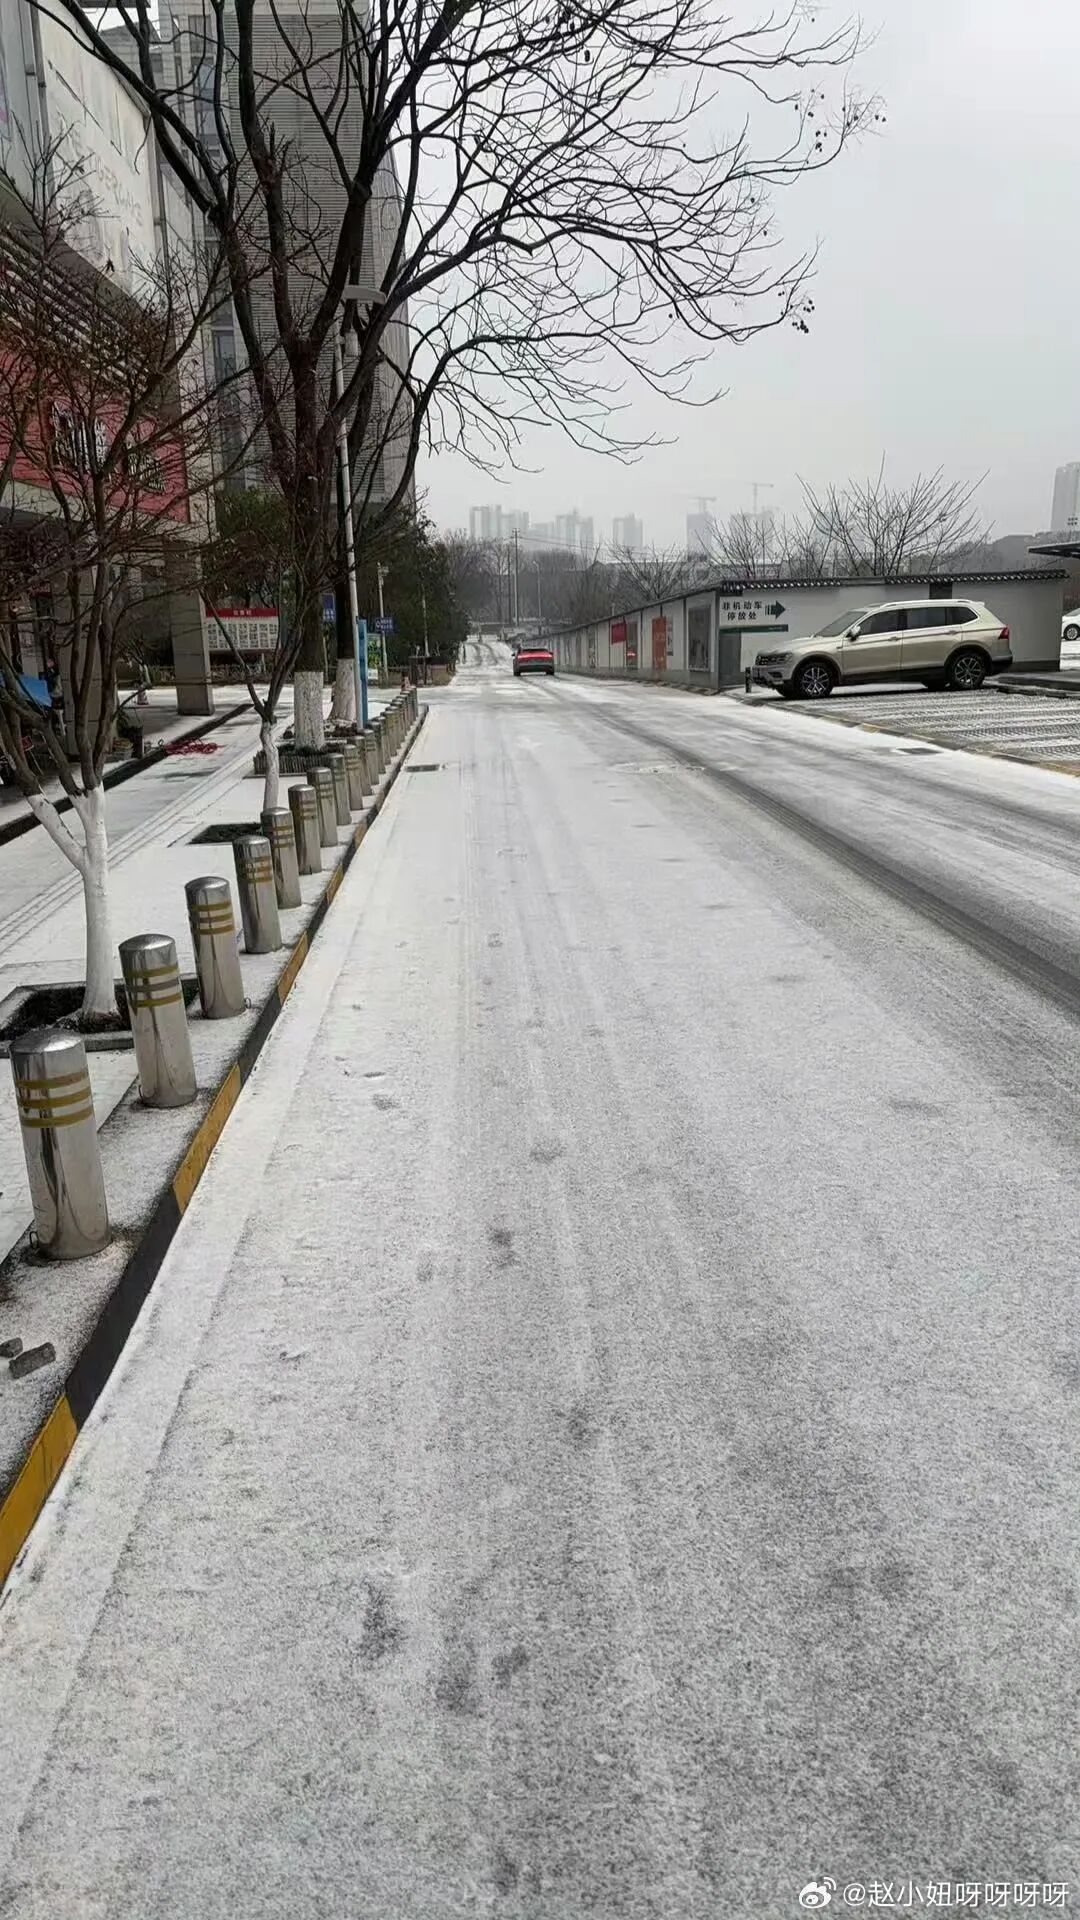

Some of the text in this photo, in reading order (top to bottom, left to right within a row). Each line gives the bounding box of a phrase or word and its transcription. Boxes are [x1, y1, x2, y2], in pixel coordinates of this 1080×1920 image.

[722, 601, 762, 610] 非机动车
[727, 611, 757, 620] 停放处
